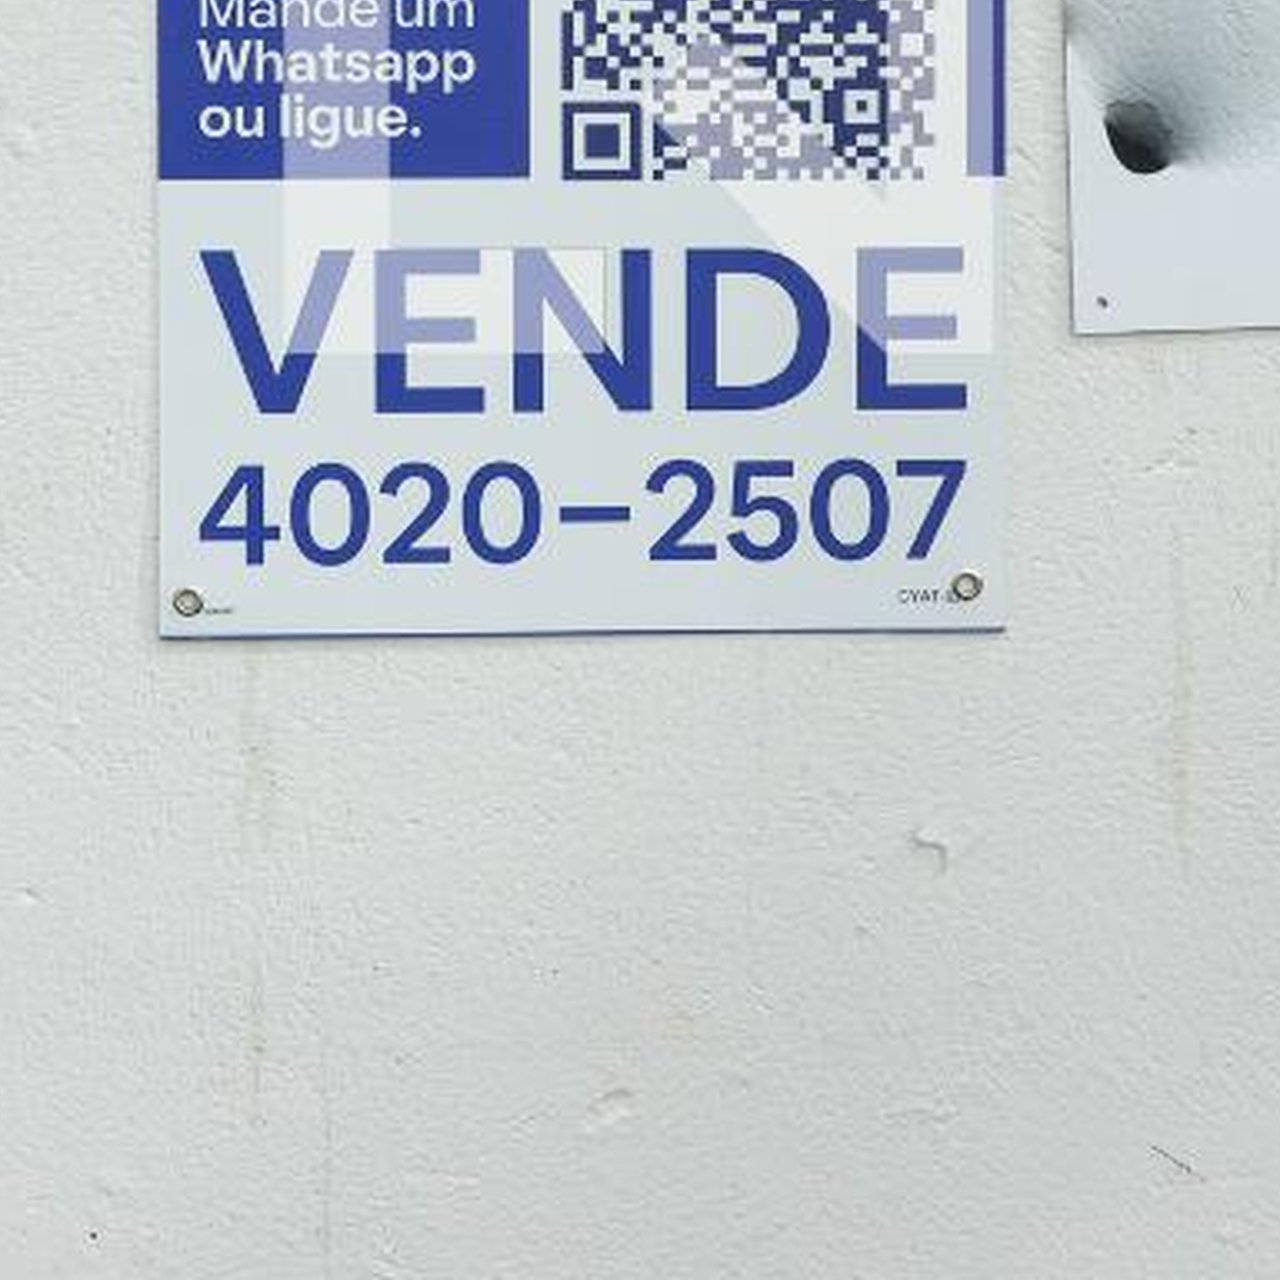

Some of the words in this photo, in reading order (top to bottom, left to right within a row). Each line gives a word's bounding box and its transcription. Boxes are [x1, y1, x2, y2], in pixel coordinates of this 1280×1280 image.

[196, 38, 477, 94] Whatsapp
[199, 104, 265, 139] ou
[279, 93, 422, 149] ligue.
[199, 247, 968, 414] VENDE
[199, 458, 968, 567] 4020-2507
